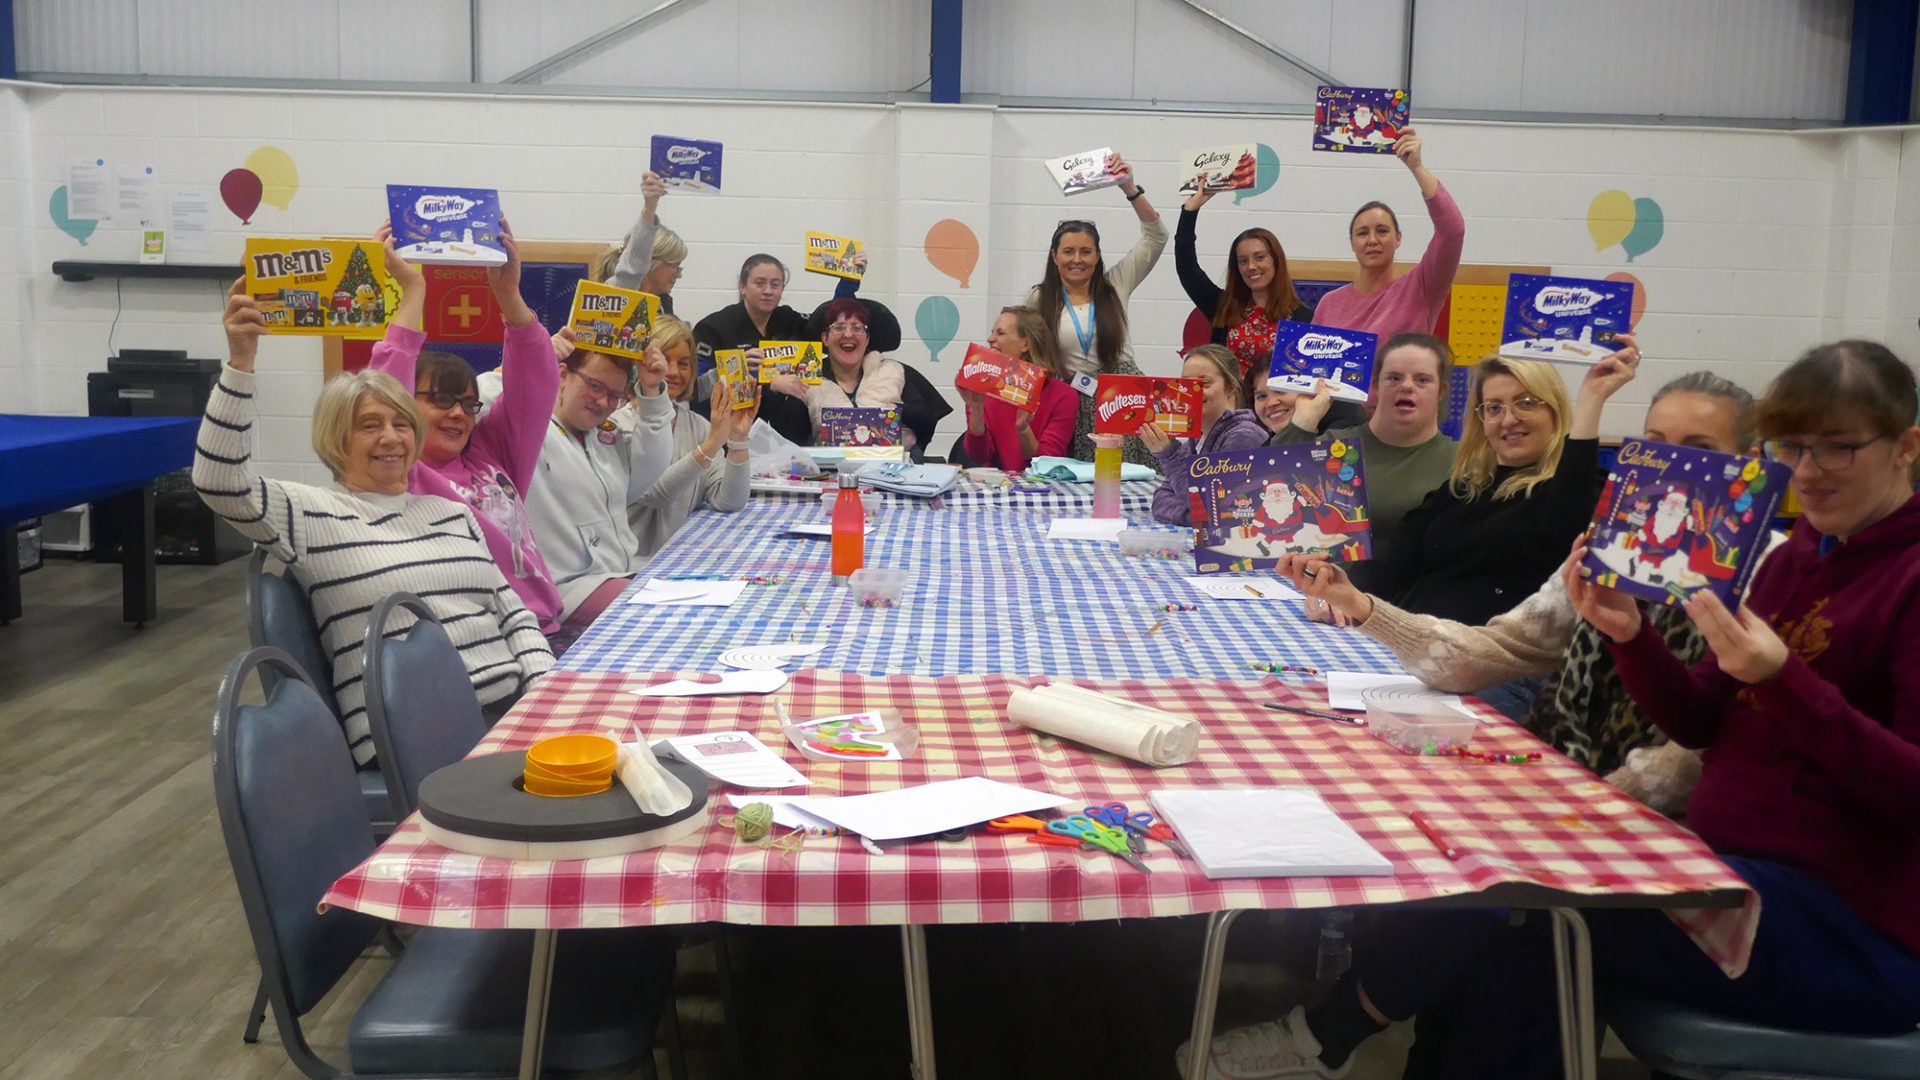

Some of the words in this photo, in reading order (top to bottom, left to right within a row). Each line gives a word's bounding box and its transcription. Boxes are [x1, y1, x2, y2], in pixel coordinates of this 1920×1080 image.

[1318, 87, 1353, 101] Cadbury
[1063, 157, 1095, 171] Galaxy
[1194, 152, 1231, 168] Galaxy
[434, 269, 488, 281] sensor
[963, 361, 1002, 379] Maltesers
[1098, 394, 1146, 422] Maltesers
[1190, 456, 1252, 478] Cadbury
[1618, 442, 1671, 475] Cadbury
